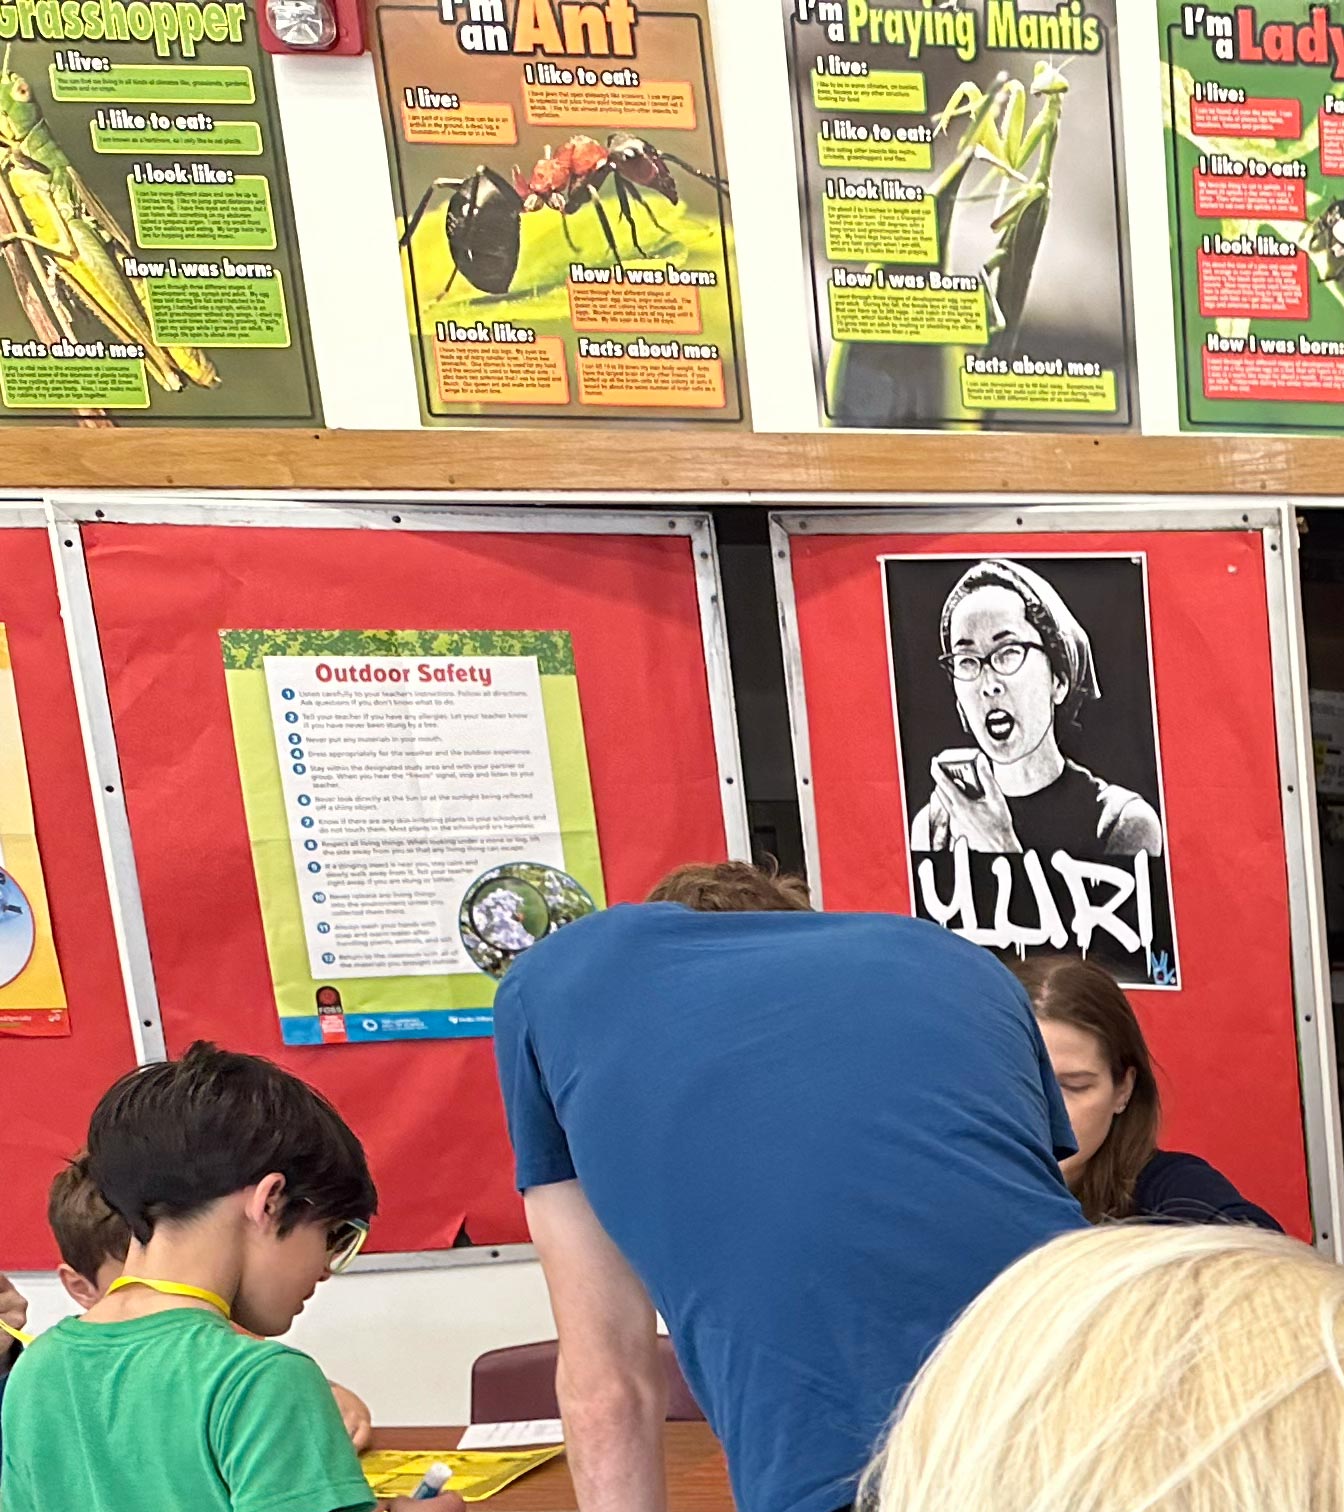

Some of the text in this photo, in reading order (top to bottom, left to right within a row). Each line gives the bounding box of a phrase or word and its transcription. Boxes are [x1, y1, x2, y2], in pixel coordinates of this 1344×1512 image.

[460, 0, 635, 56] an Ant
[828, 0, 1100, 60] a Praying Mantis
[1184, 7, 1232, 37] I'm
[54, 50, 110, 71] I live:
[1215, 39, 1233, 60] a
[525, 63, 640, 86] I like to eat:
[816, 54, 868, 75] I live:
[405, 87, 459, 108] I live:
[1195, 81, 1245, 102] I live:
[97, 109, 213, 130] I like to eat:
[822, 120, 932, 142] I like to eat:
[133, 162, 234, 184] I look like:
[1200, 154, 1307, 178] I like to eat:
[827, 178, 923, 201] I look like:
[1203, 234, 1296, 256] I look like:
[124, 257, 273, 277] How I was born:
[571, 263, 717, 285] How I was born:
[833, 268, 978, 290] How I was Born:
[437, 322, 535, 342] I look like:
[1207, 333, 1245, 352] How
[1249, 334, 1256, 353] I
[1260, 340, 1295, 353] was
[1, 338, 144, 358] Facts about me:
[580, 338, 719, 359] Facts about me:
[966, 354, 1101, 376] Facts about me:
[315, 662, 492, 687] Outdoor Safety
[917, 835, 1154, 970] YURI
